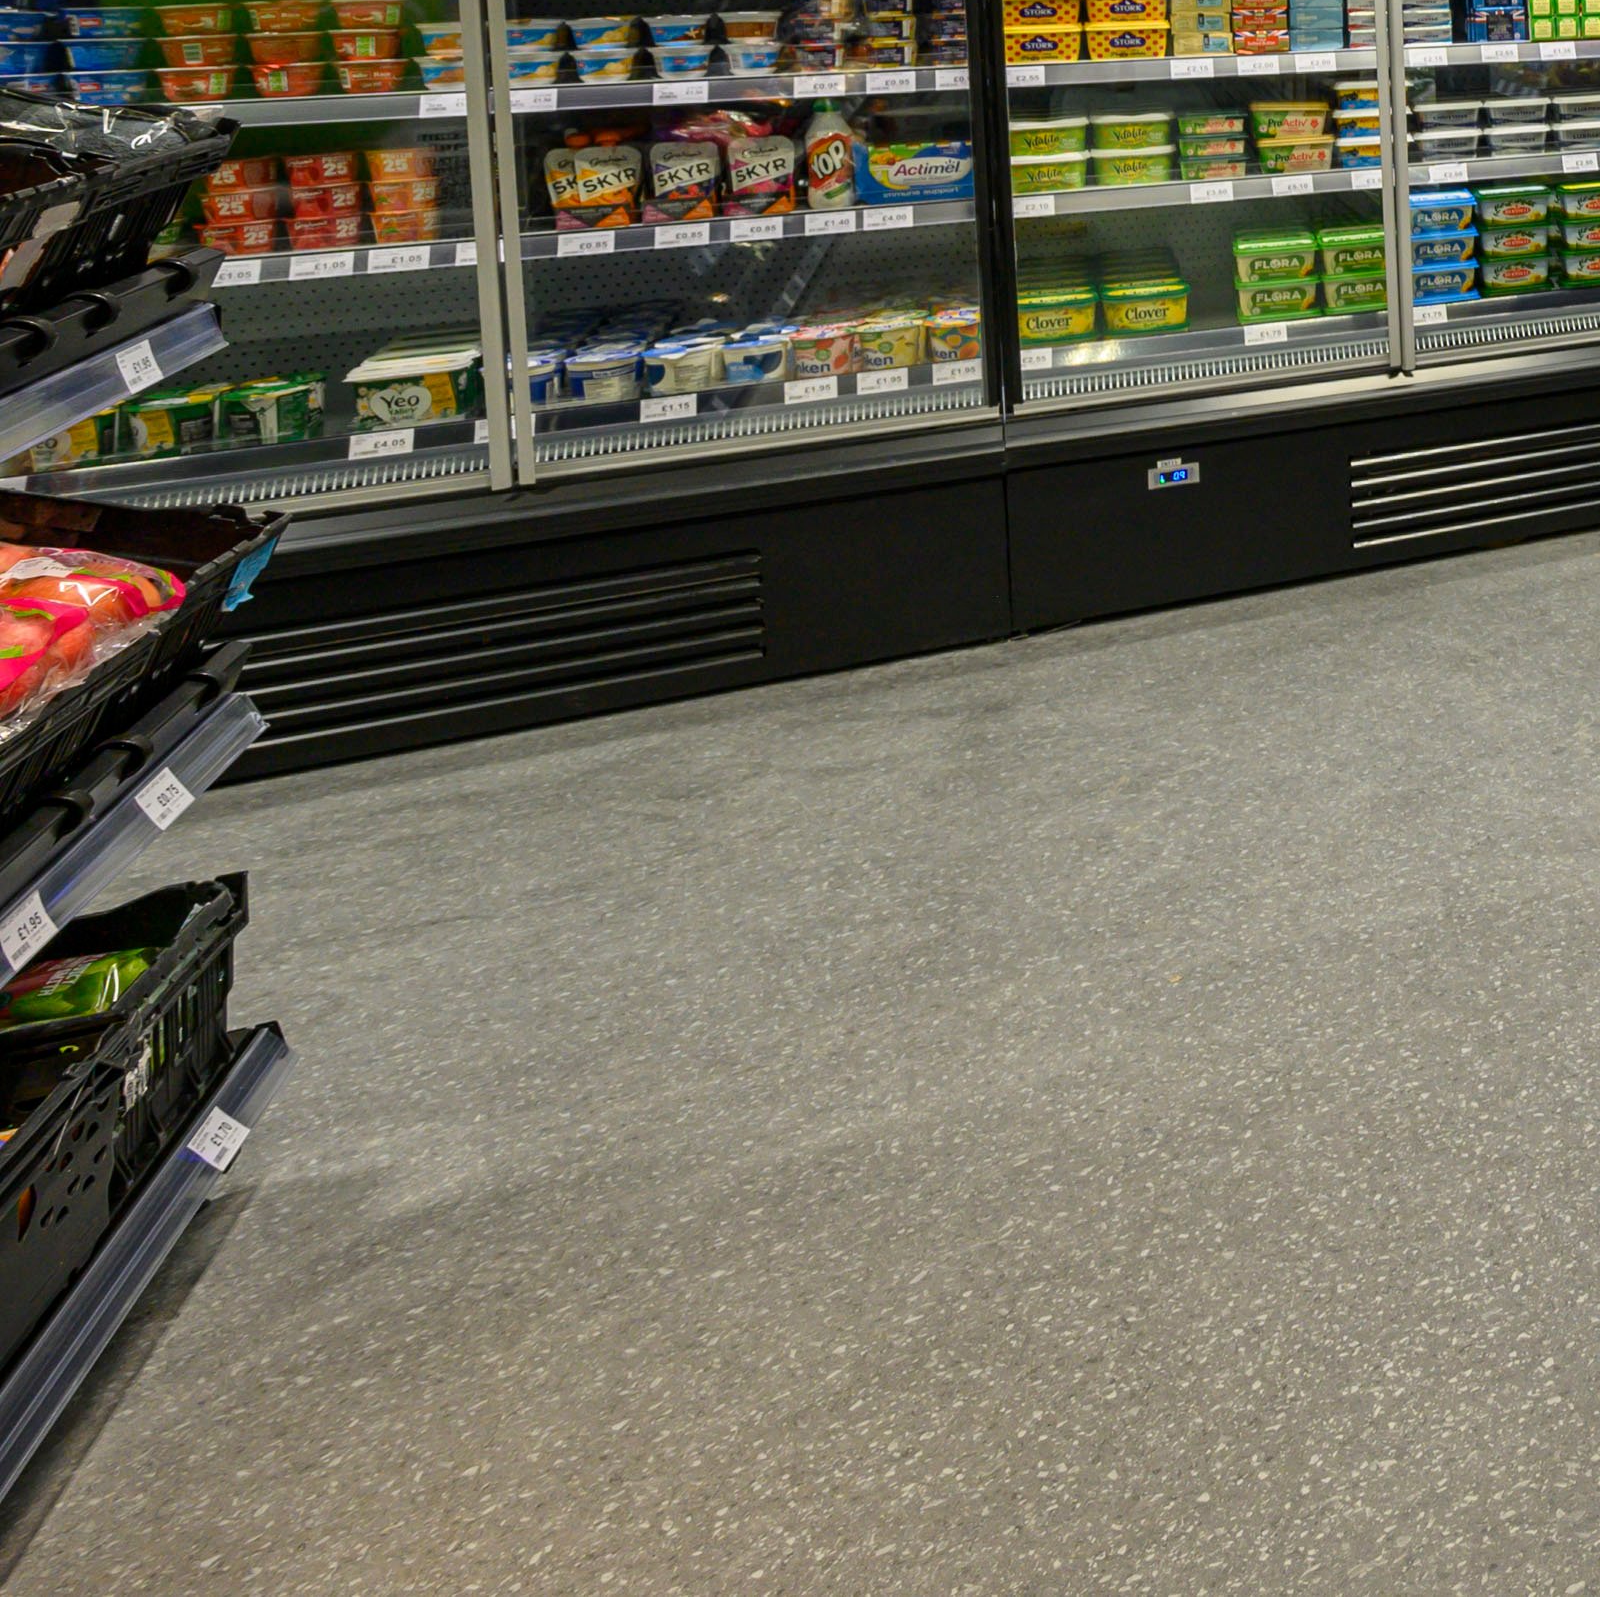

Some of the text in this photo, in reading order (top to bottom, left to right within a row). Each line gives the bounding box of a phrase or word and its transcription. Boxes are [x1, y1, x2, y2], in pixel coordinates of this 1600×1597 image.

[812, 140, 844, 179] YOP
[894, 159, 962, 178] Actimel
[657, 163, 712, 186] SKYR
[736, 157, 786, 182] SKYR
[583, 167, 636, 192] SKYR
[1417, 211, 1460, 223] FLORA
[1255, 257, 1300, 270] FLORA
[1026, 315, 1073, 331] Clover
[1124, 306, 1170, 321] Clover
